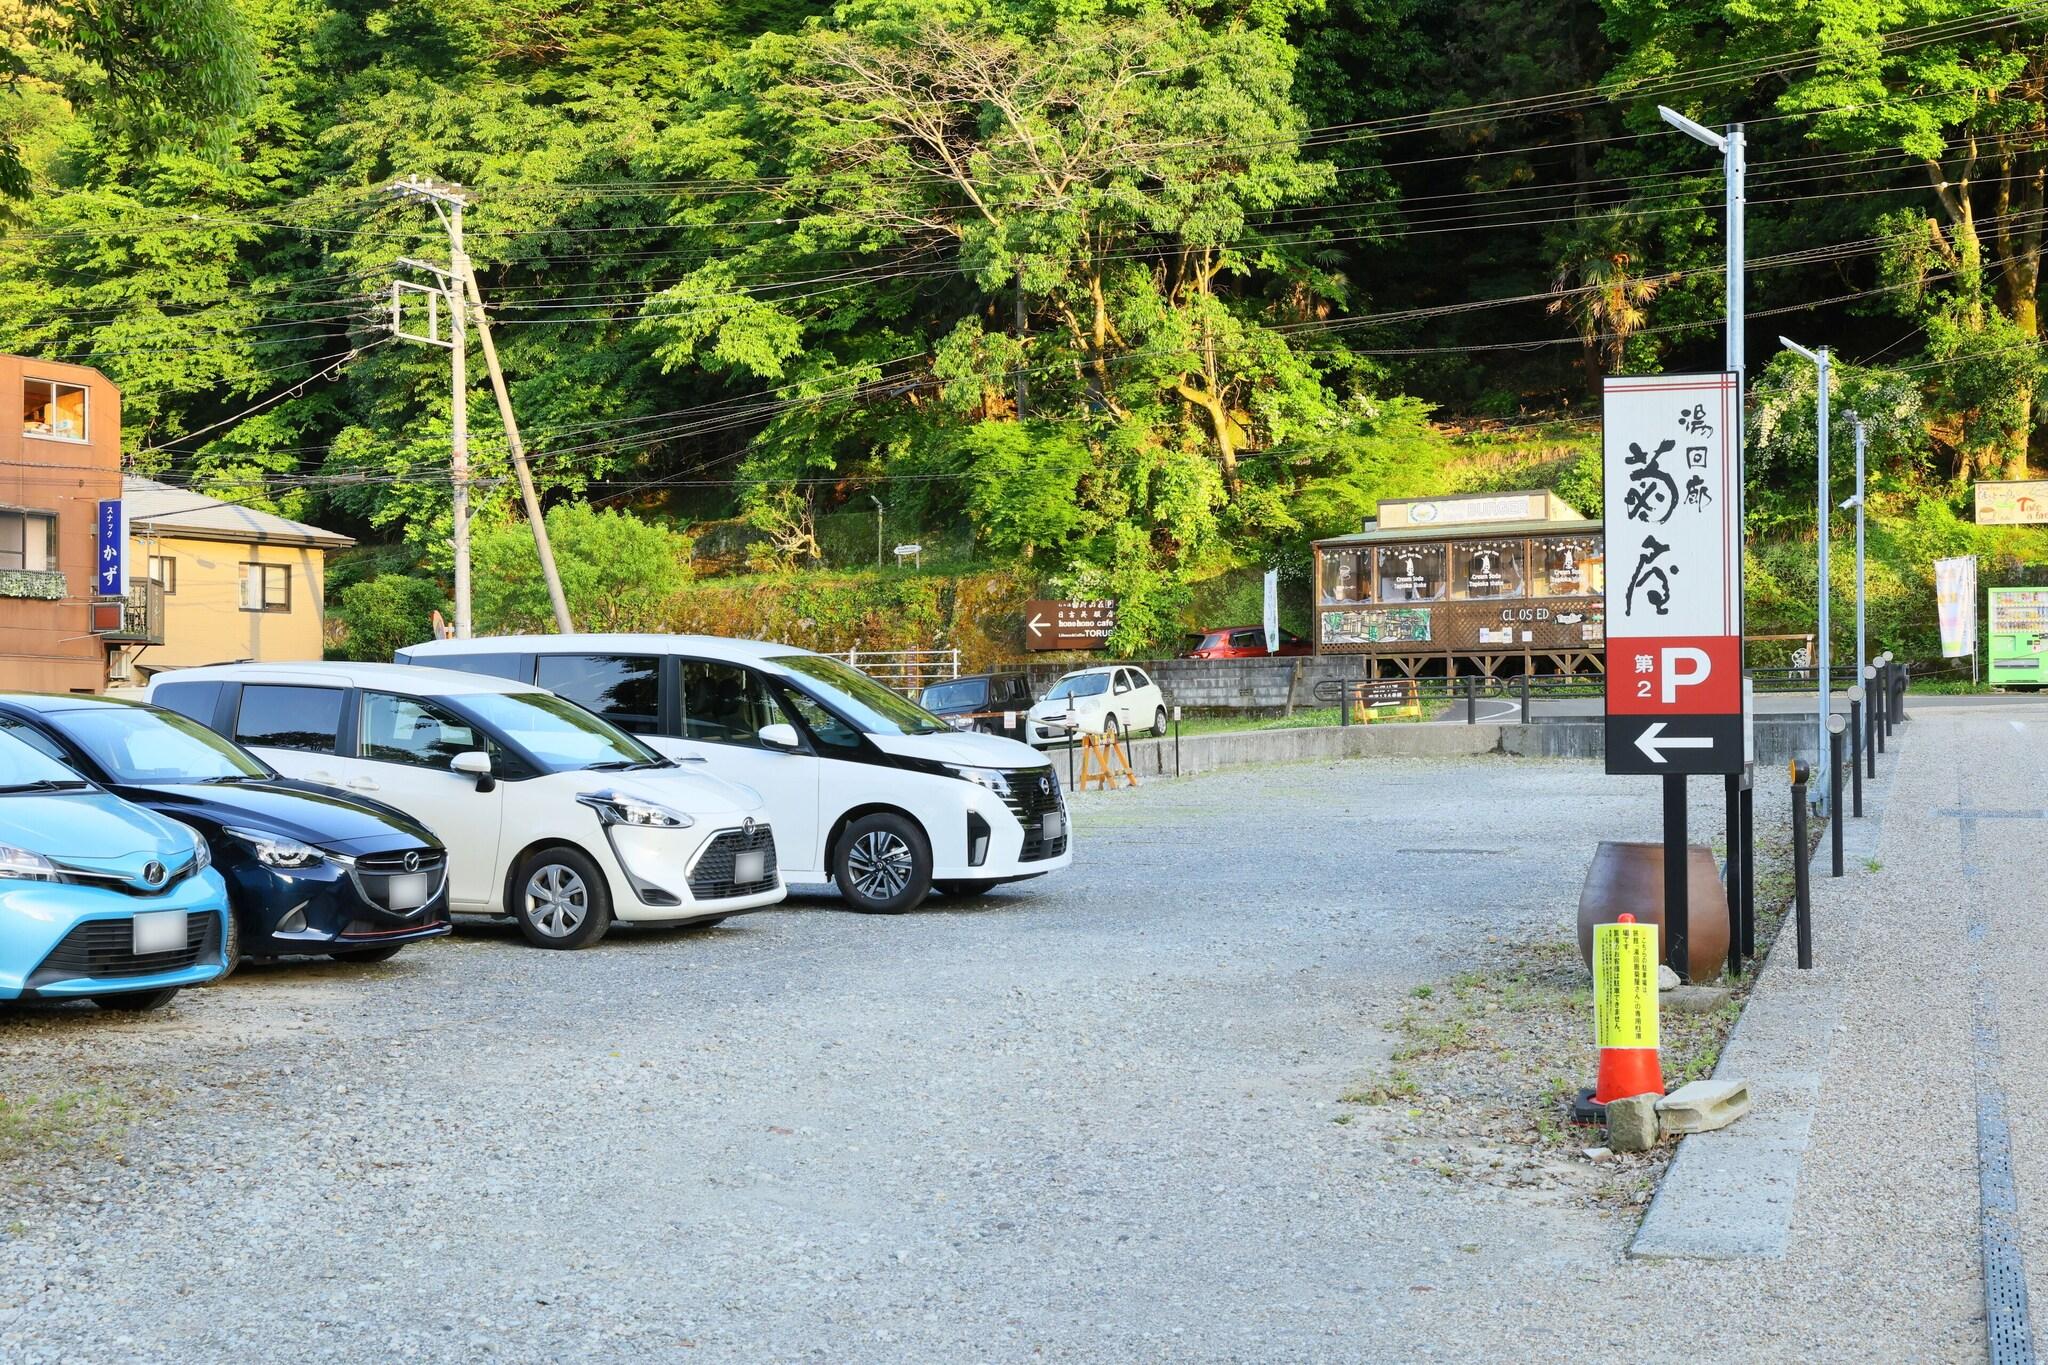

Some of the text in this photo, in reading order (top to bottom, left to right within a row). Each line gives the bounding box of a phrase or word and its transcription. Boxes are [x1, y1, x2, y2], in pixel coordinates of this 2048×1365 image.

[1678, 403, 1714, 513] 湯回廊
[1467, 499, 1529, 516] BURGER
[1625, 438, 1680, 617] 菊屋
[102, 506, 118, 586] スナック かず
[1096, 619, 1114, 627] cafe
[1661, 647, 1712, 704] P
